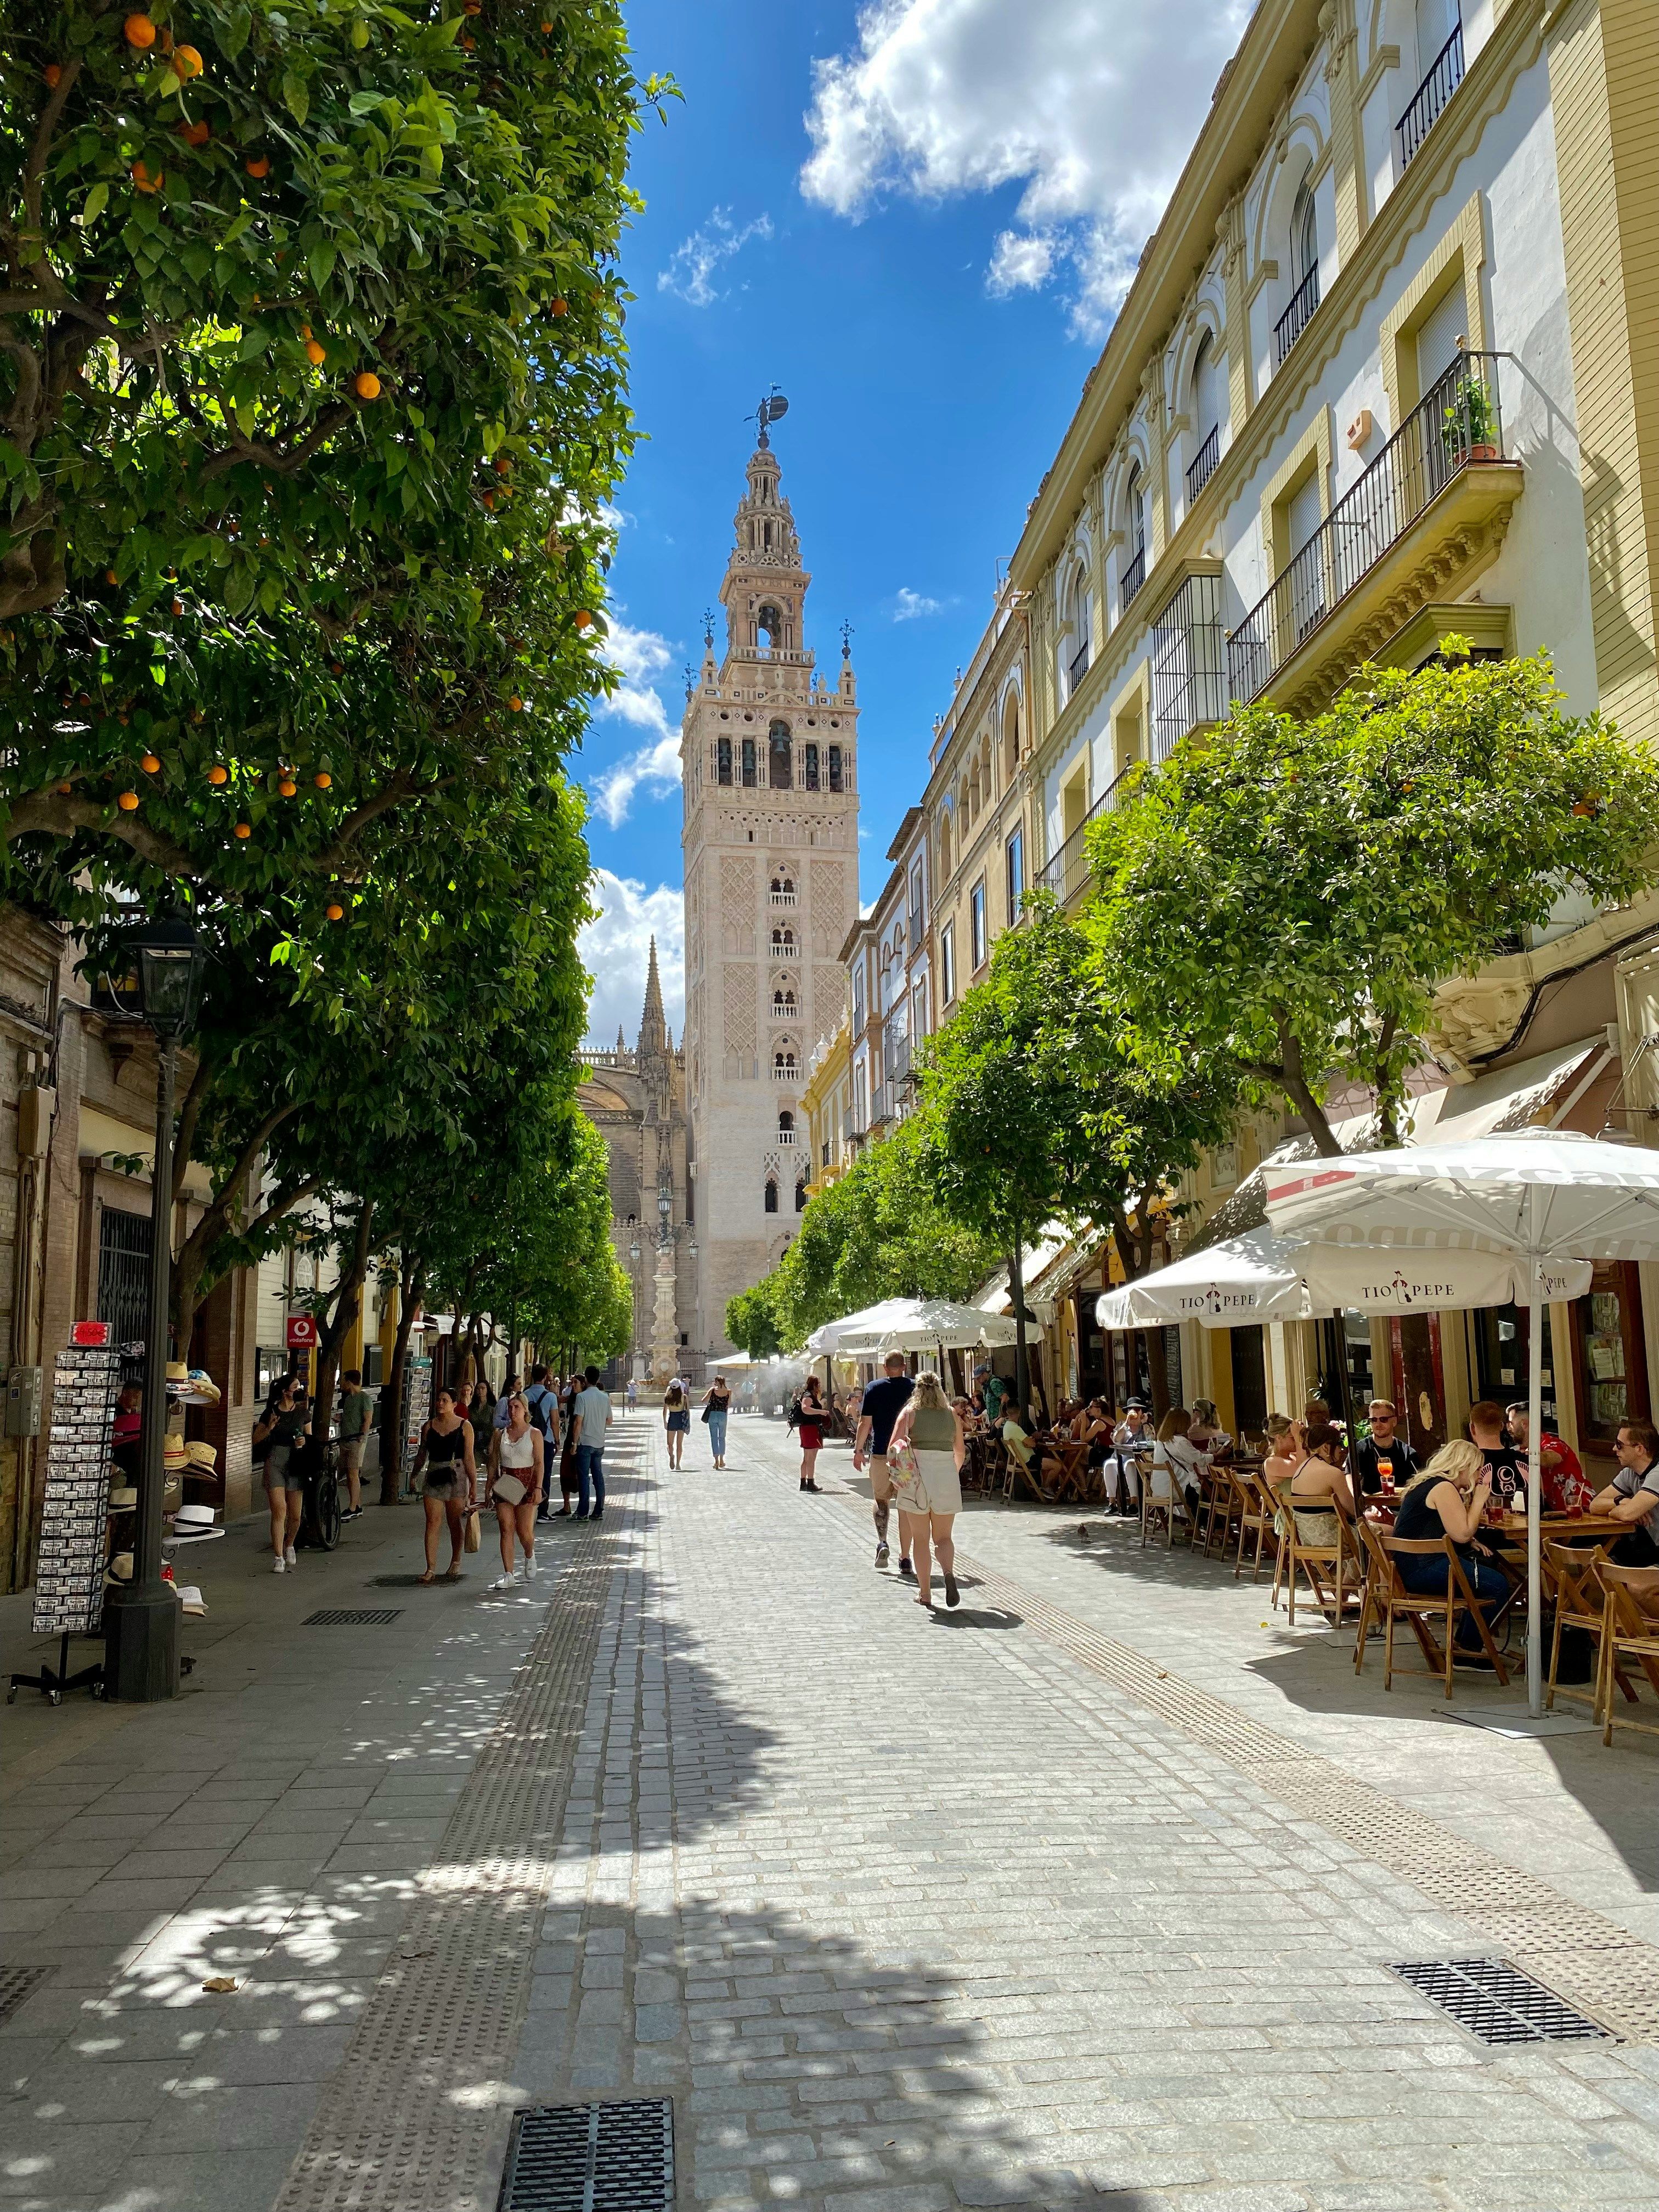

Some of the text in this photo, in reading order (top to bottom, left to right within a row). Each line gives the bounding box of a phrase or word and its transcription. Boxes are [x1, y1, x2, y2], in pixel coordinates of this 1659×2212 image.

[1548, 1278, 1567, 1288] PEPE
[1362, 1284, 1455, 1298] TIO PEPE
[1180, 1294, 1255, 1309] TIO PEPE
